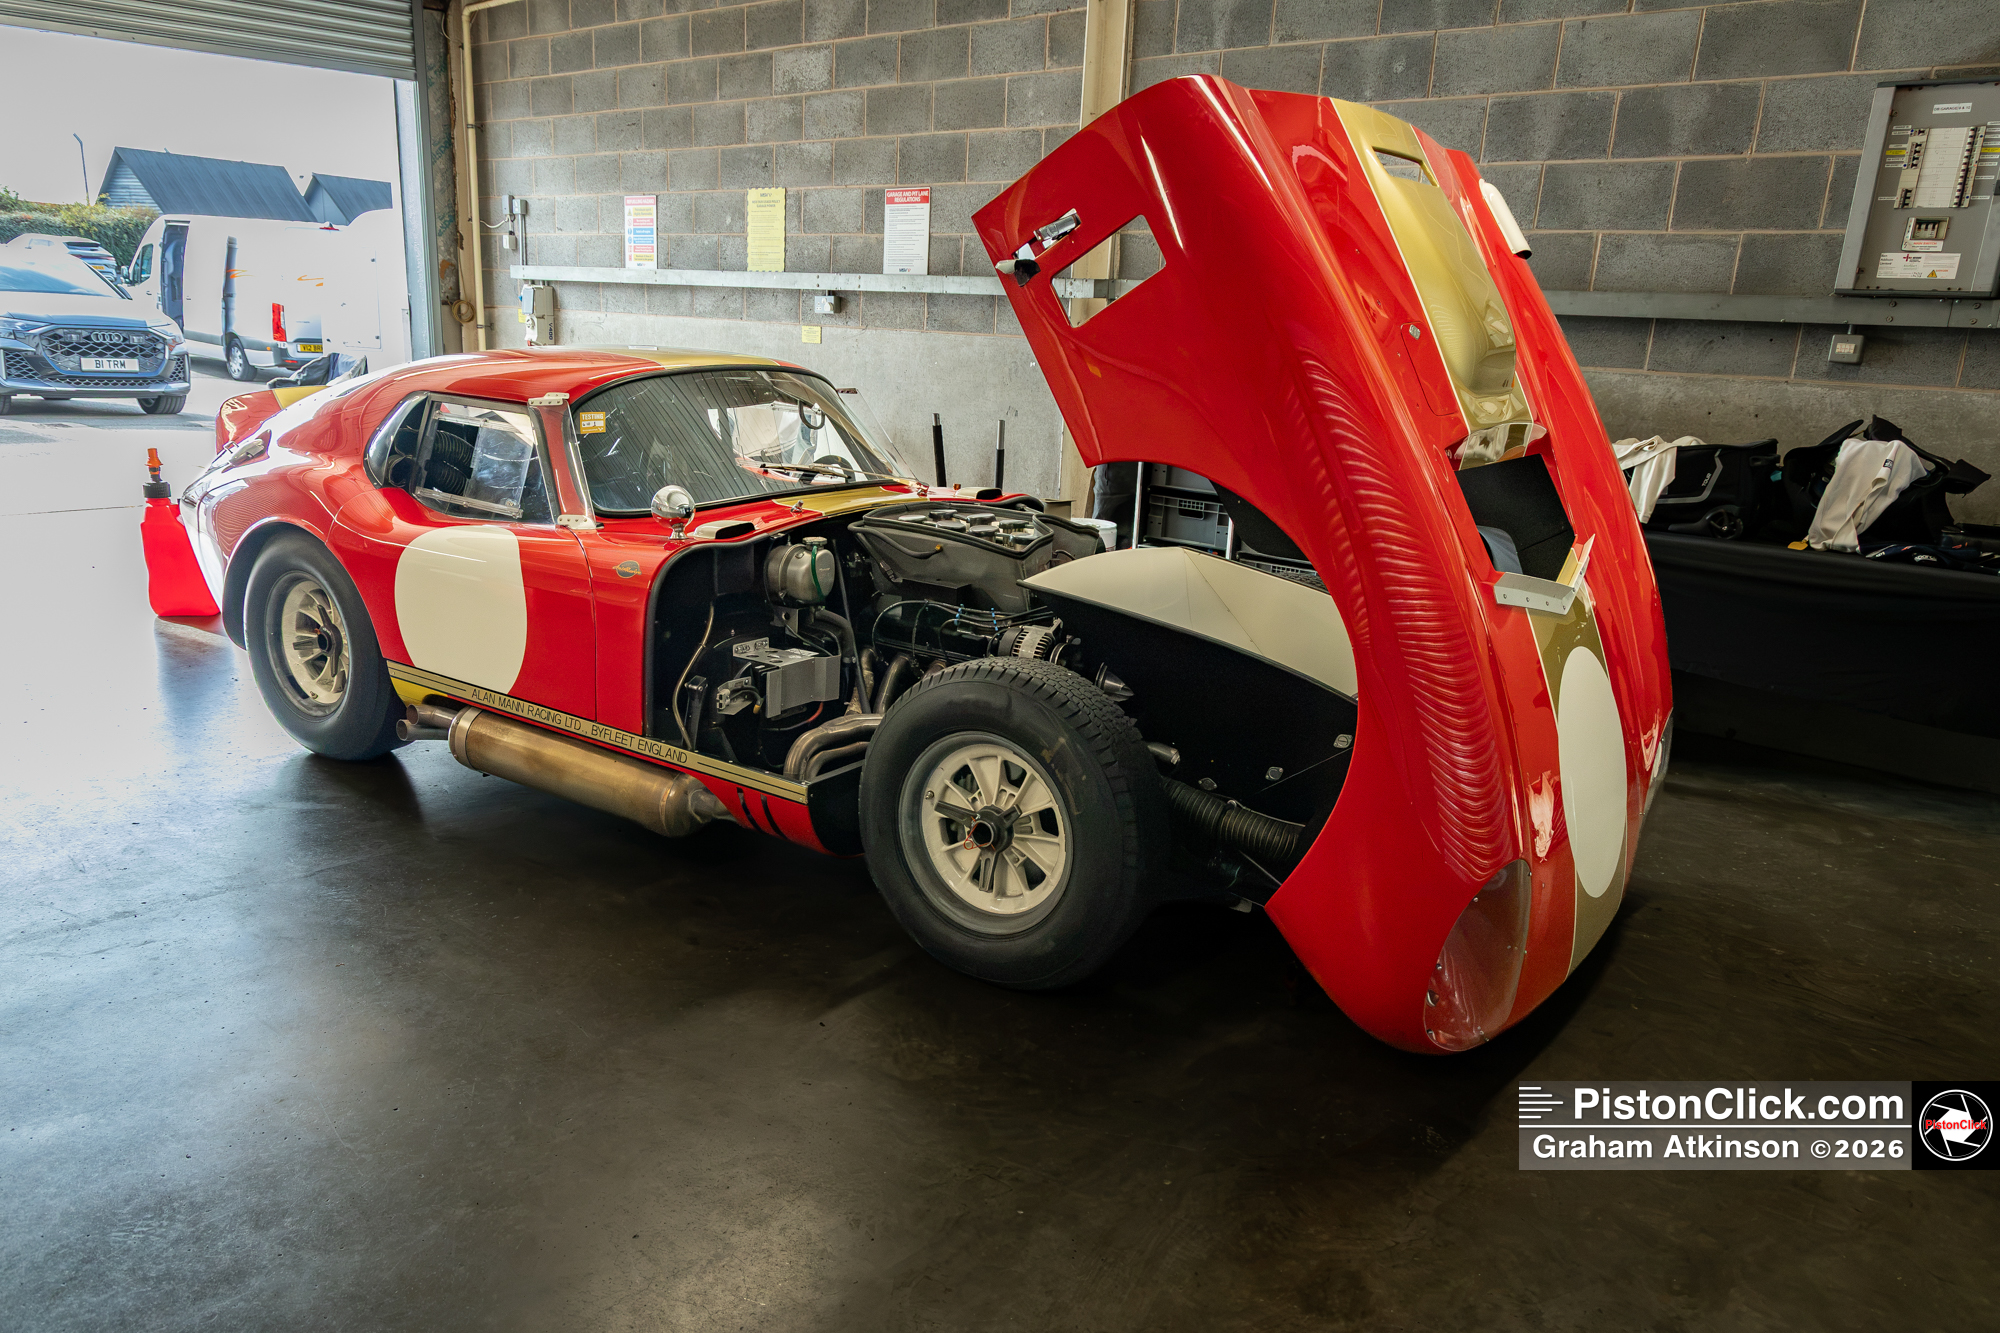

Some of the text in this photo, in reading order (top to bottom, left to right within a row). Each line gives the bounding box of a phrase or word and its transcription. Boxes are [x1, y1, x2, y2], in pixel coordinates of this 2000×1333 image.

[106, 359, 126, 369] TRM
[471, 688, 496, 704] ALAN
[499, 696, 524, 713] MANN
[527, 704, 562, 725] RACING
[591, 724, 635, 747] BYFLEET
[637, 740, 688, 764] ENGLAND
